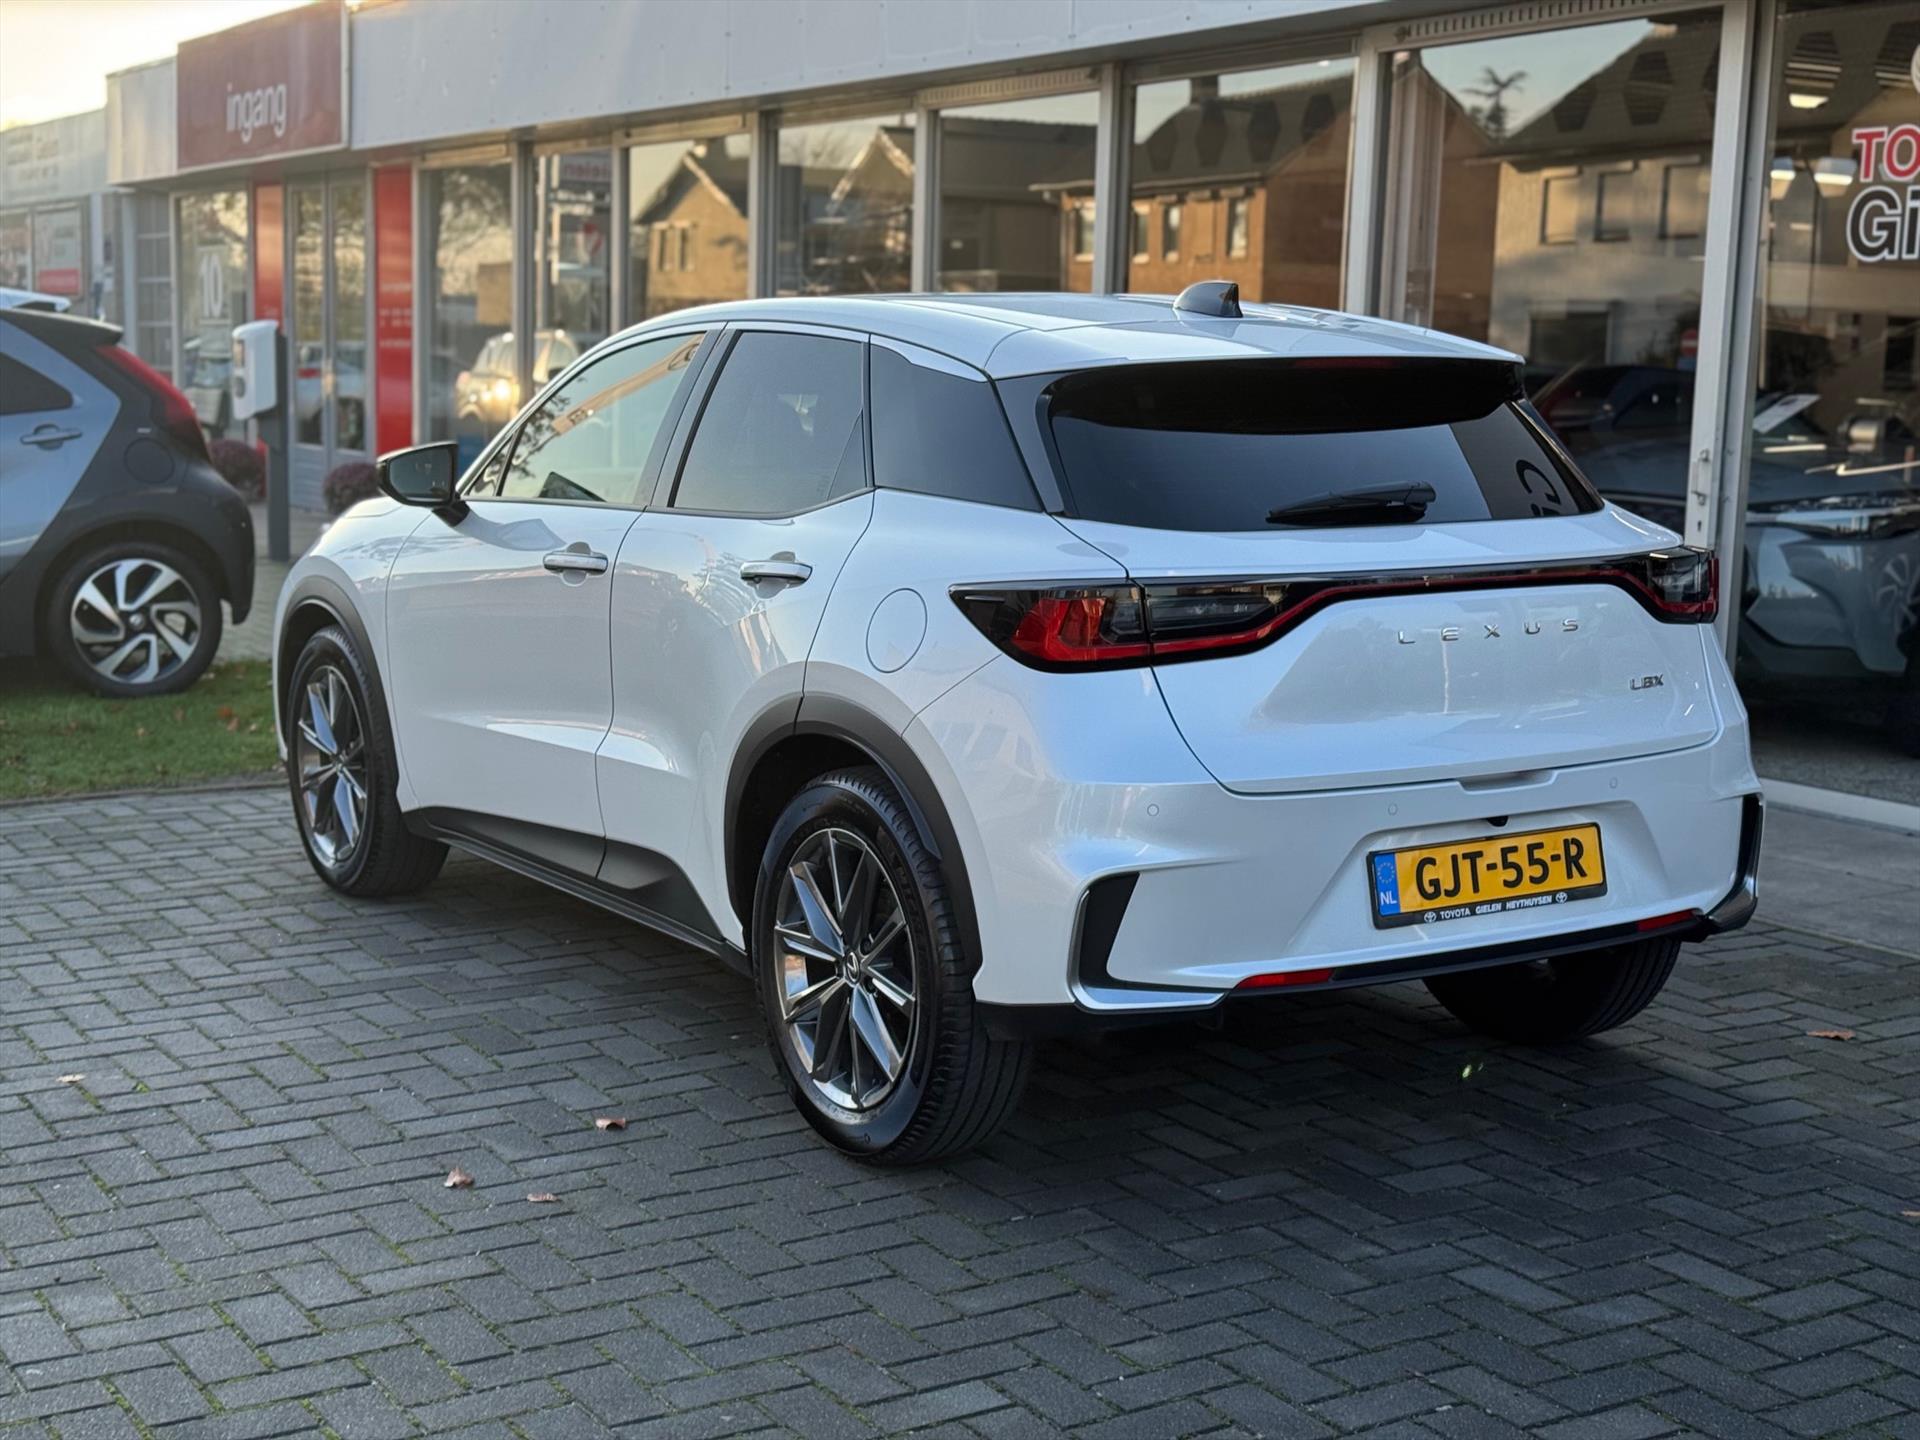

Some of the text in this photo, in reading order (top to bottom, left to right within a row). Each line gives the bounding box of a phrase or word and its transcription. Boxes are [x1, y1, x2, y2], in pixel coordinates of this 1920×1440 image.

[226, 82, 287, 143] ingang
[1852, 124, 1920, 183] TO
[1846, 185, 1920, 262] Gi
[198, 253, 224, 318] 10
[1397, 618, 1579, 645] LEXUS
[1629, 674, 1664, 691] LBX
[1380, 890, 1397, 905] NL
[1415, 837, 1588, 901] GJT-55-R
[1439, 895, 1553, 920] TOYOTA GIELEN HEYTHUYSEN
